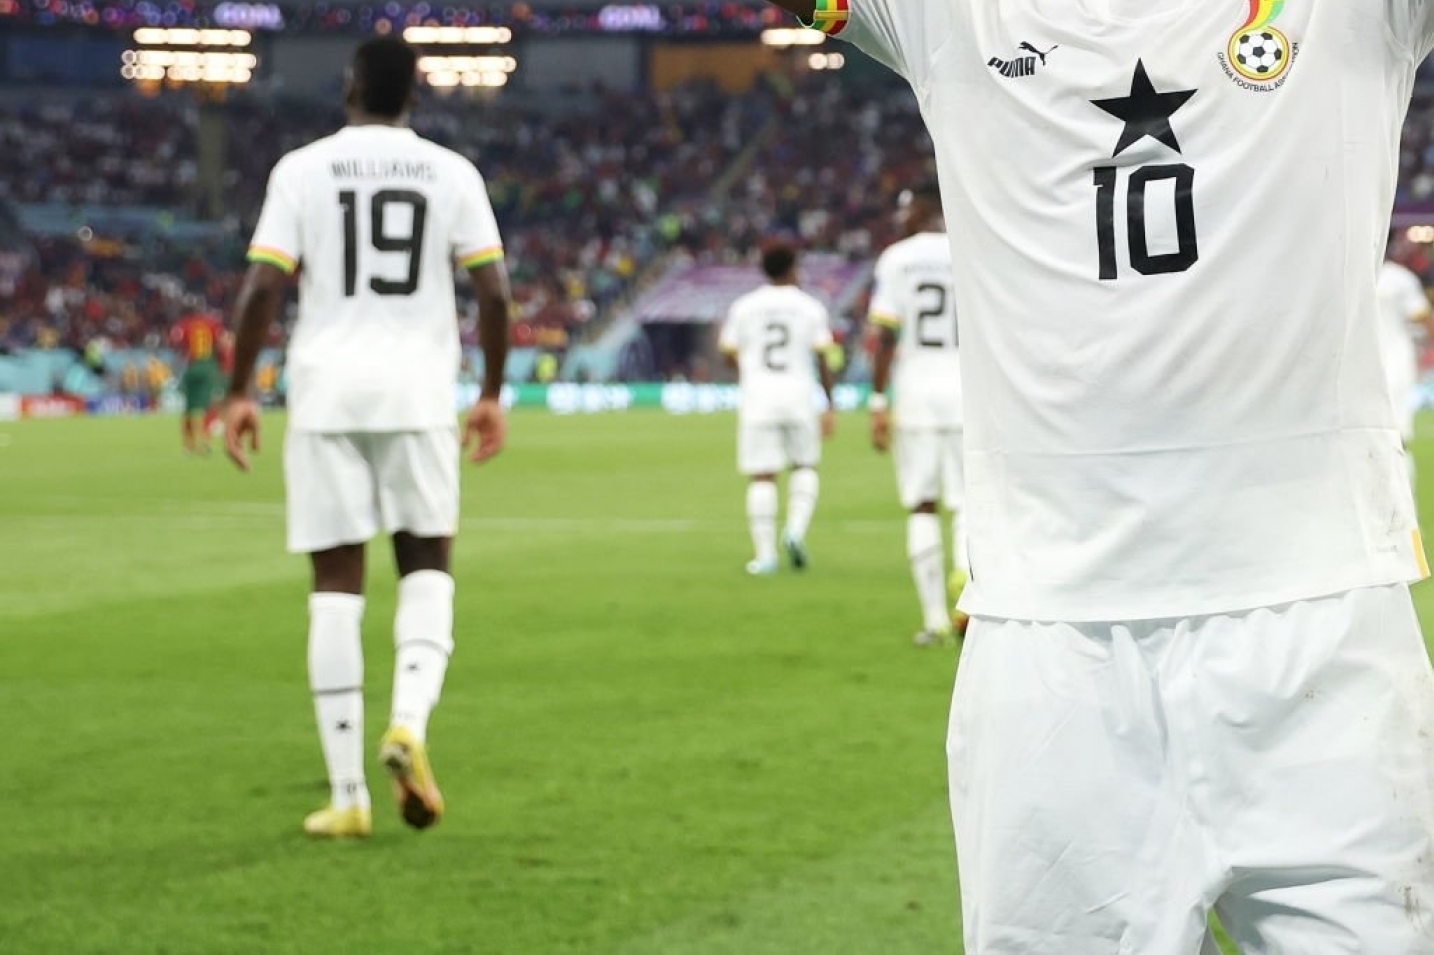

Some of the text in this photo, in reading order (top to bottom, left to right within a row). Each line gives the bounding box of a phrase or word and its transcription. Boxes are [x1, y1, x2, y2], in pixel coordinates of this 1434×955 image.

[986, 56, 1036, 78] PUMA
[1217, 52, 1234, 79] GHANA
[1232, 77, 1275, 93] FOOTBALL
[337, 189, 428, 297] 19
[1092, 162, 1199, 280] 10
[763, 322, 791, 372] 2
